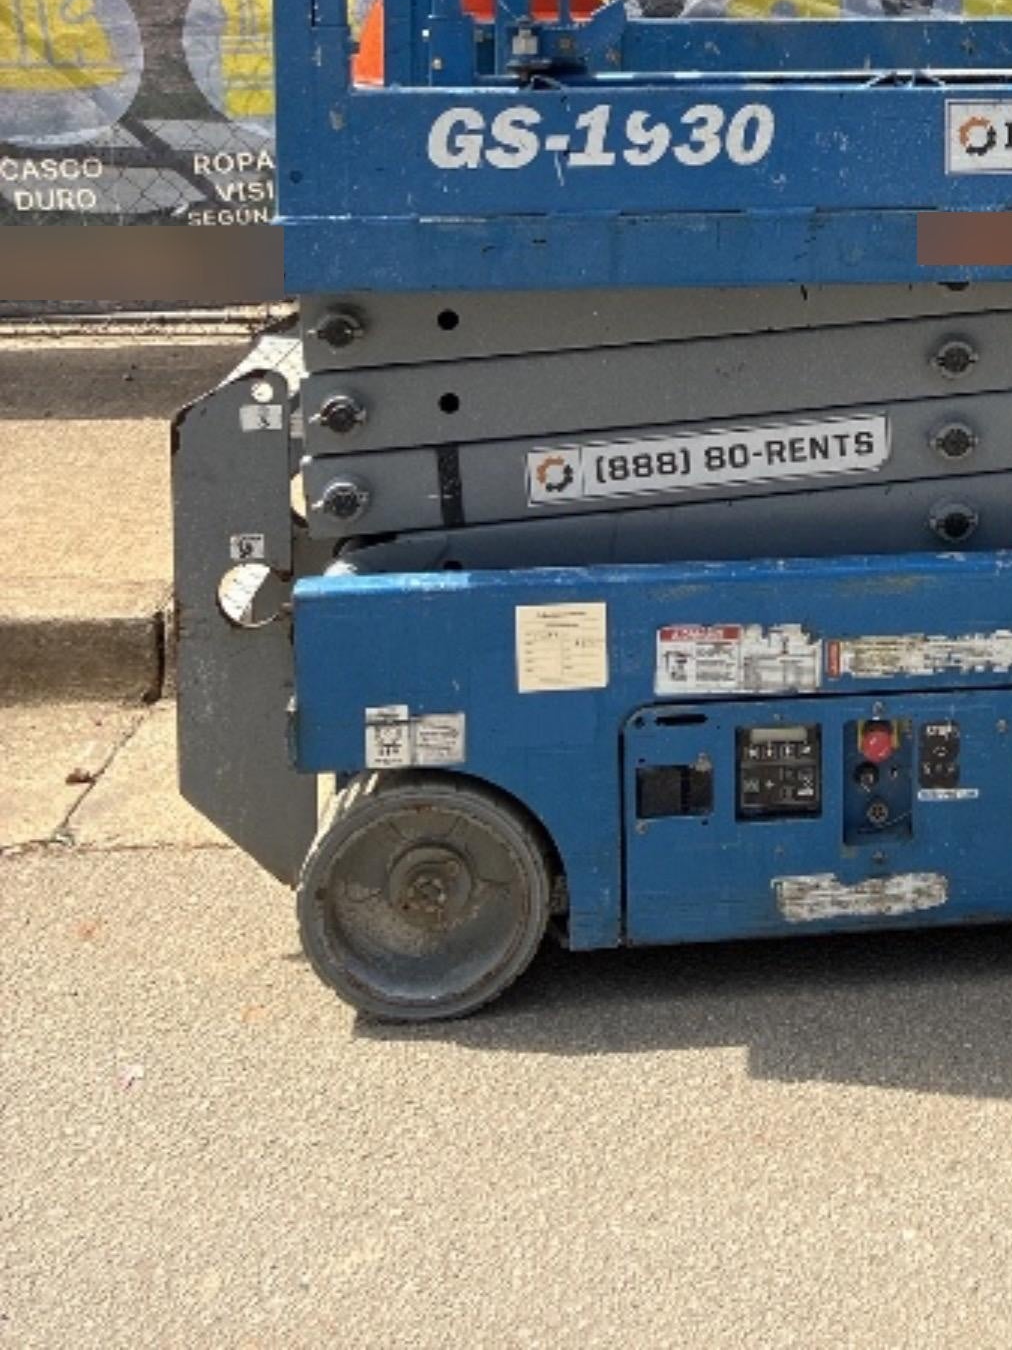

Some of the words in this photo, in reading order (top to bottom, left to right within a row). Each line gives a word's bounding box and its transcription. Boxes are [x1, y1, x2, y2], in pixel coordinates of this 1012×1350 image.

[427, 104, 775, 169] GS-1930
[0, 157, 103, 182] CASCO
[193, 150, 276, 176] ROPA
[14, 188, 98, 212] DURO
[704, 430, 875, 473] 80-RENTS
